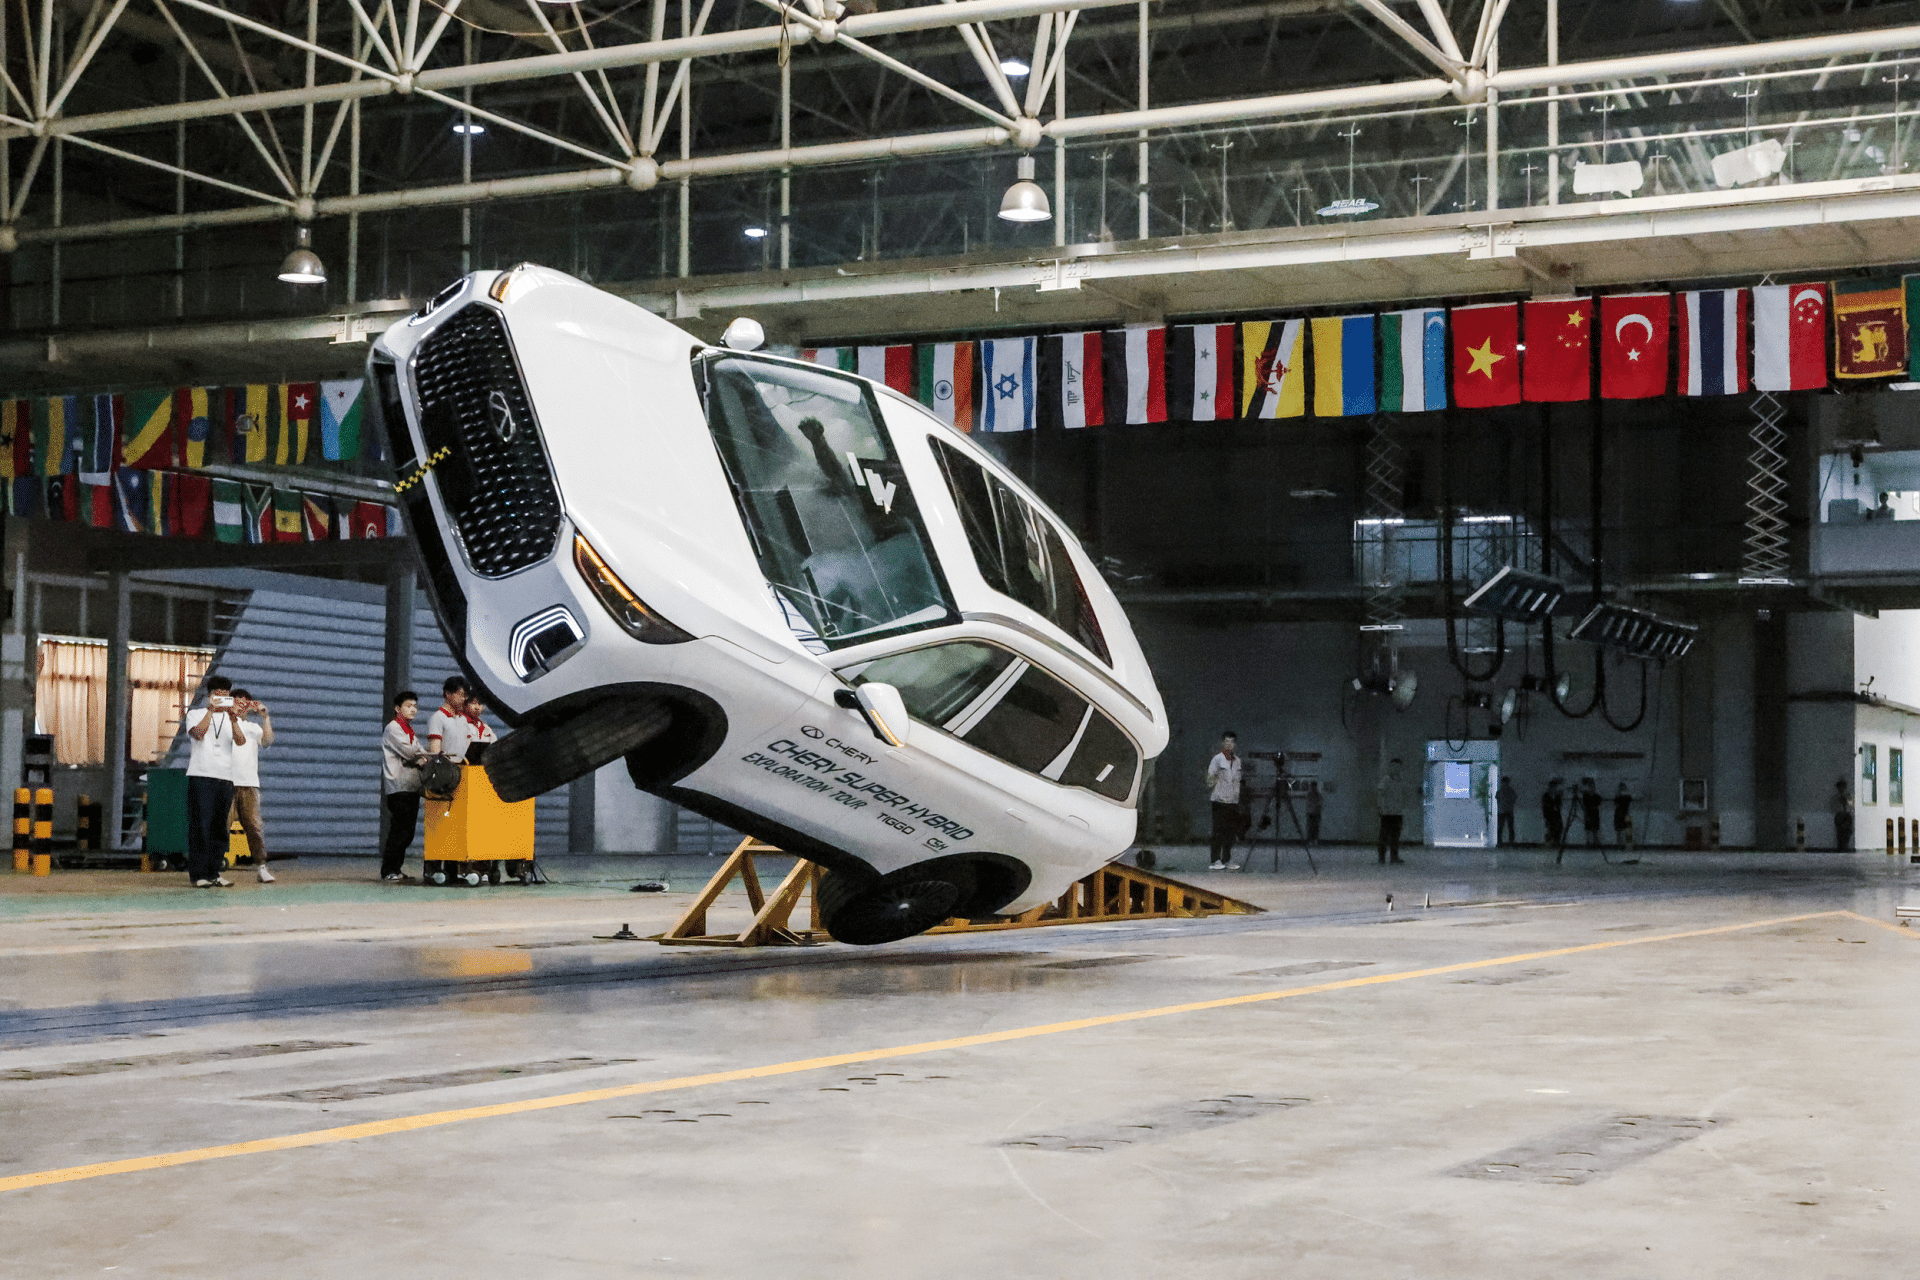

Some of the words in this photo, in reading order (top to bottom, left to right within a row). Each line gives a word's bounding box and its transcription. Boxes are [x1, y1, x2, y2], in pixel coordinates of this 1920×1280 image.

[825, 738, 879, 766] CHERY
[741, 752, 834, 793] EXPLORATION
[828, 790, 868, 810] TOUR
[767, 739, 846, 774] CHERY
[834, 772, 910, 808] SUPER
[900, 803, 975, 841] HYBRID
[877, 812, 916, 836] TIGGO
